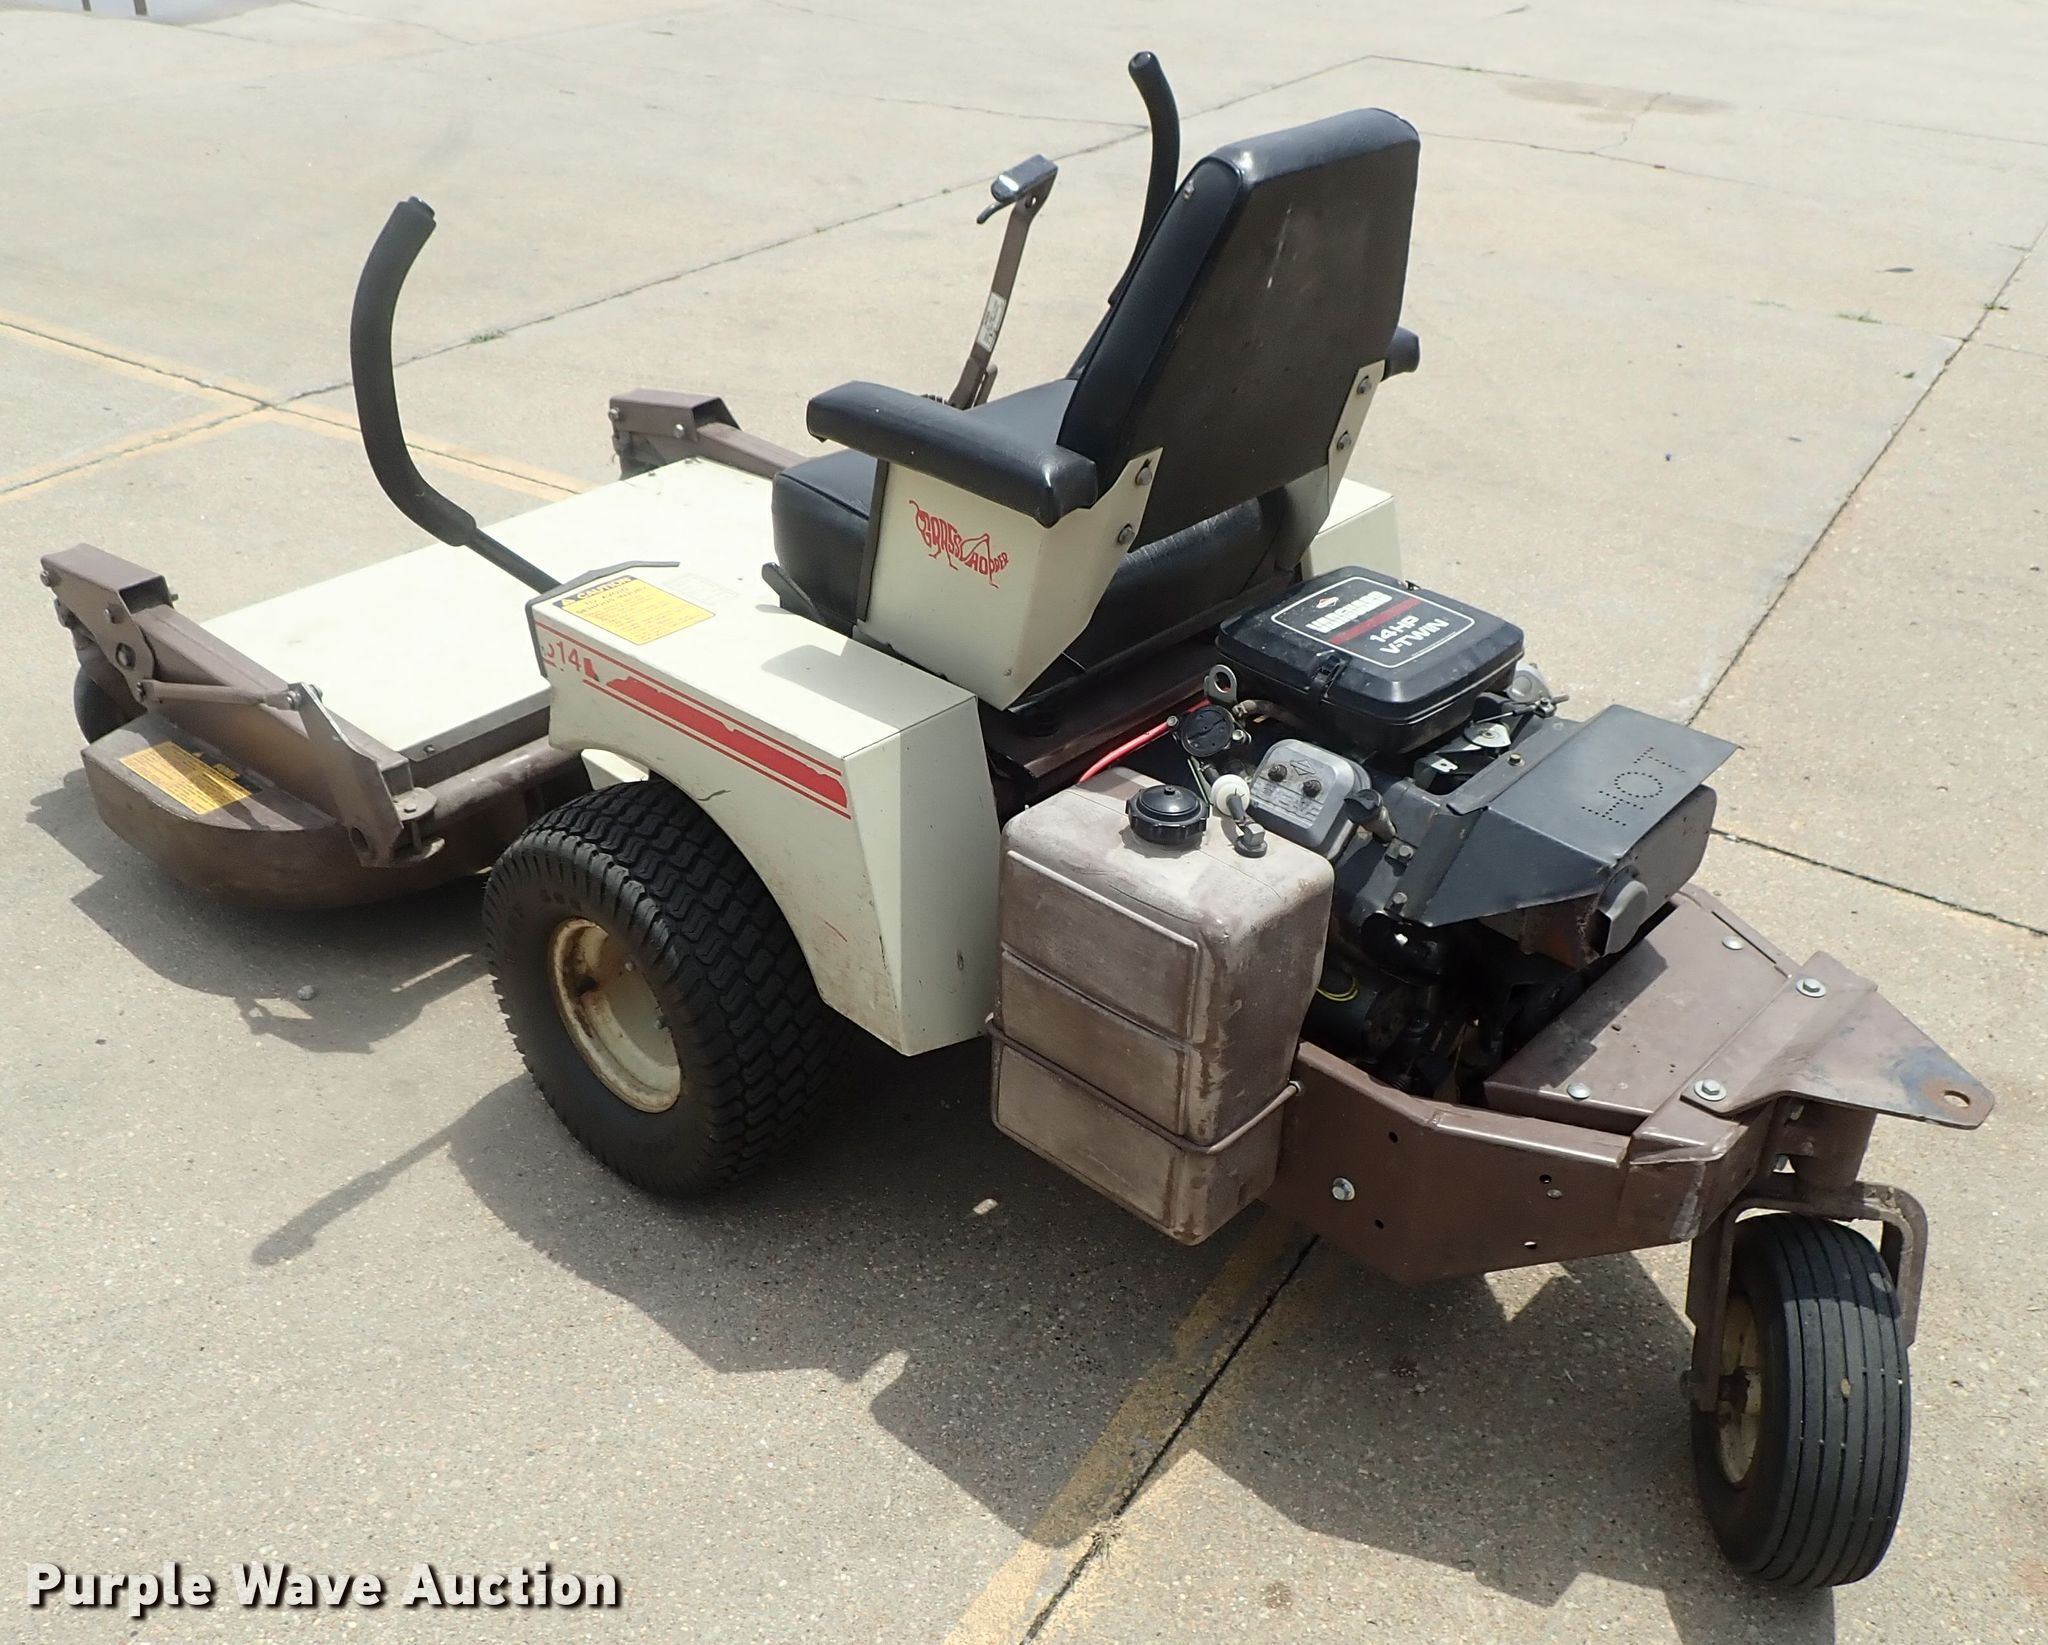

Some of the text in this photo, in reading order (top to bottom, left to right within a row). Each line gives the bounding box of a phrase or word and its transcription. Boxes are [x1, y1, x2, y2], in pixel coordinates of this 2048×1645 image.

[915, 508, 1009, 577] GRASSHOPPER
[576, 577, 633, 600] CAUTION
[1379, 618, 1450, 654] V-TWIN
[1581, 746, 1687, 826] HOT
